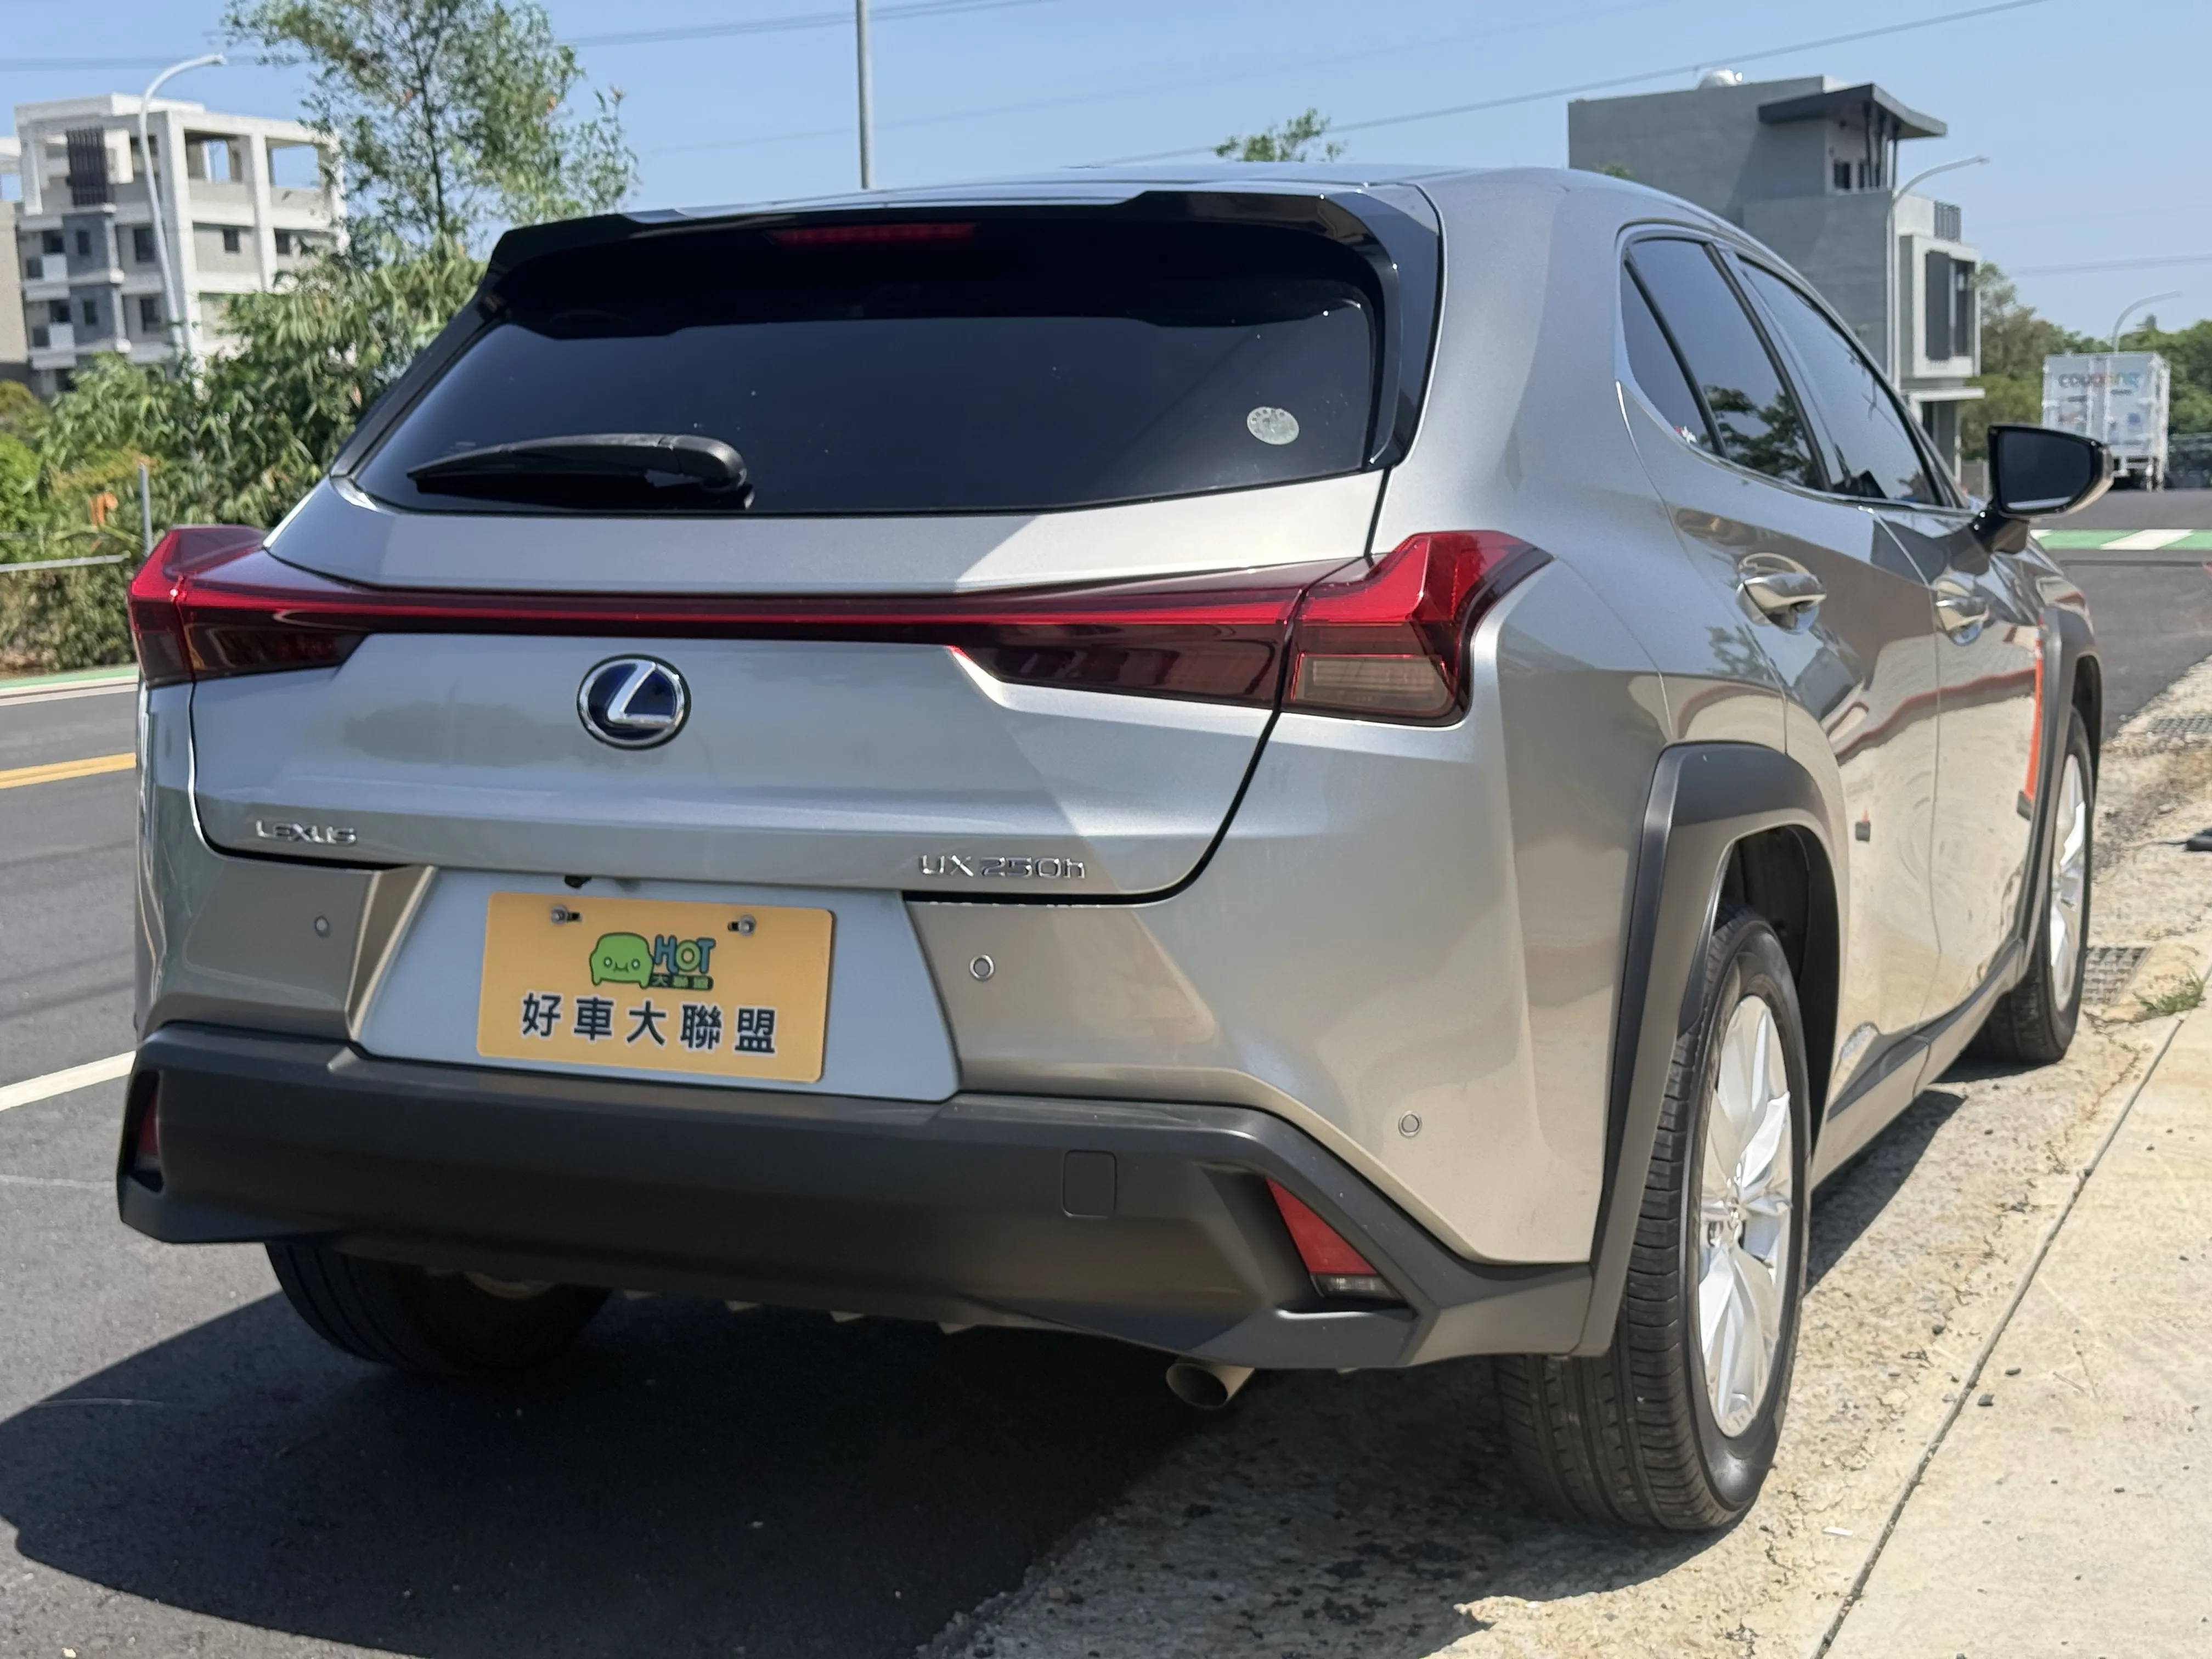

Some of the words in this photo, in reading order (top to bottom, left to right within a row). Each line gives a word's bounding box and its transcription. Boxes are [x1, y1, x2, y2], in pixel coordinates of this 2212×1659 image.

[256, 820, 357, 845] LEXUS
[654, 934, 716, 974] HOT
[522, 992, 776, 1054] 好車大聯盟
